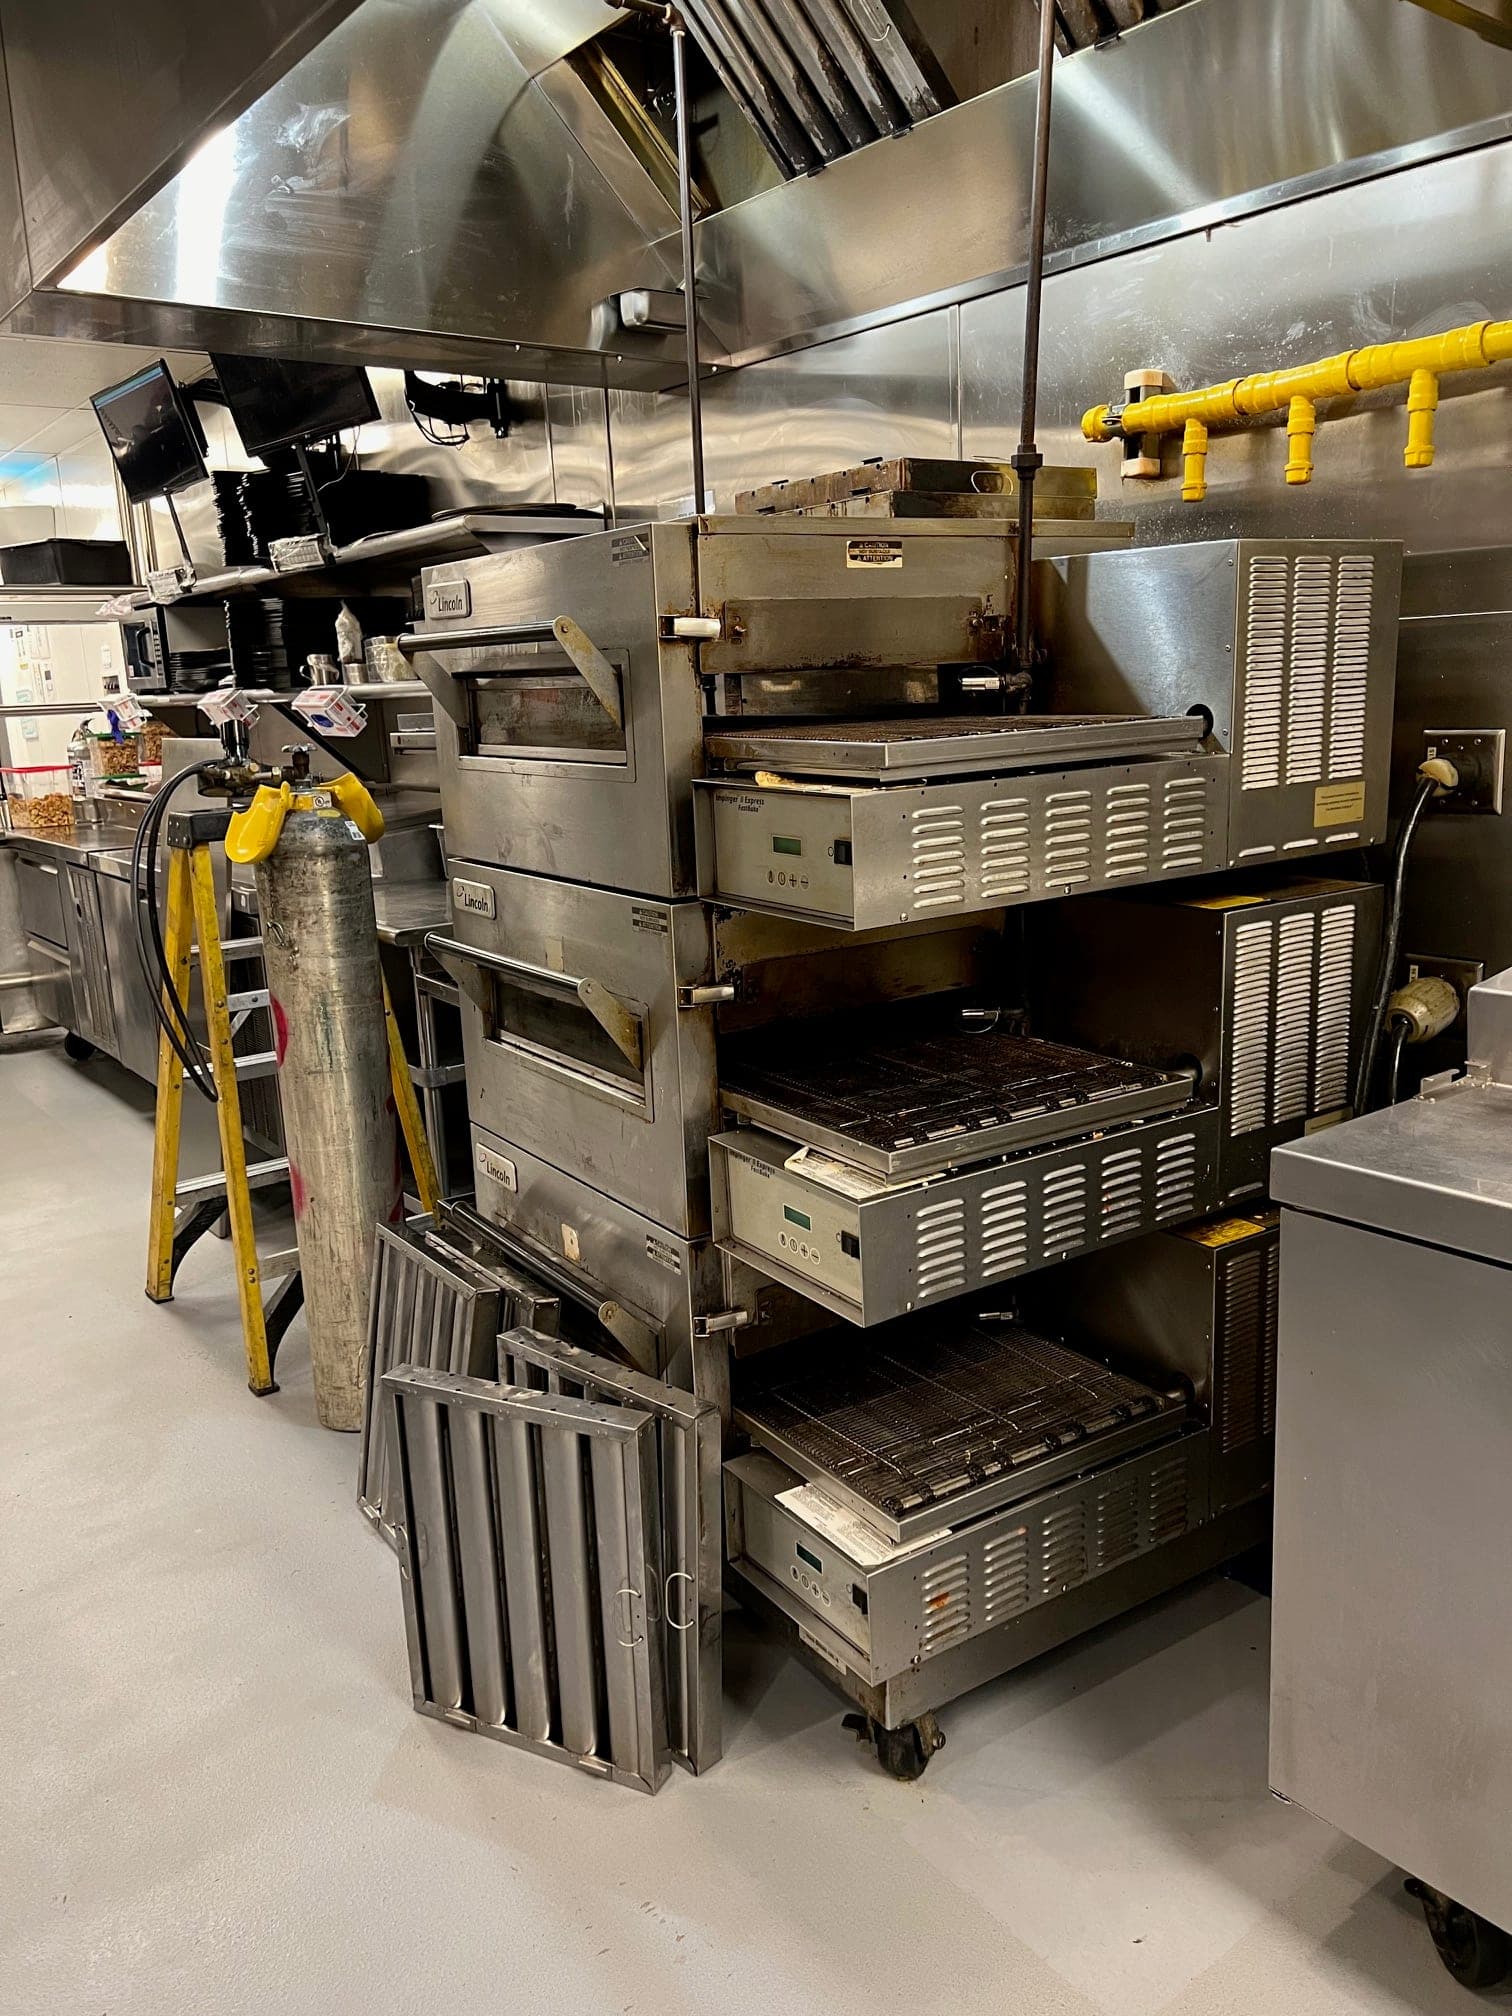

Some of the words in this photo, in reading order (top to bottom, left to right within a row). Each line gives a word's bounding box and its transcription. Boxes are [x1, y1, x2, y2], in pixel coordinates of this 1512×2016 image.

[438, 594, 463, 612] Lincoln
[744, 796, 765, 805] Express
[464, 893, 489, 912] Lincoln
[486, 1161, 511, 1186] Lincoln
